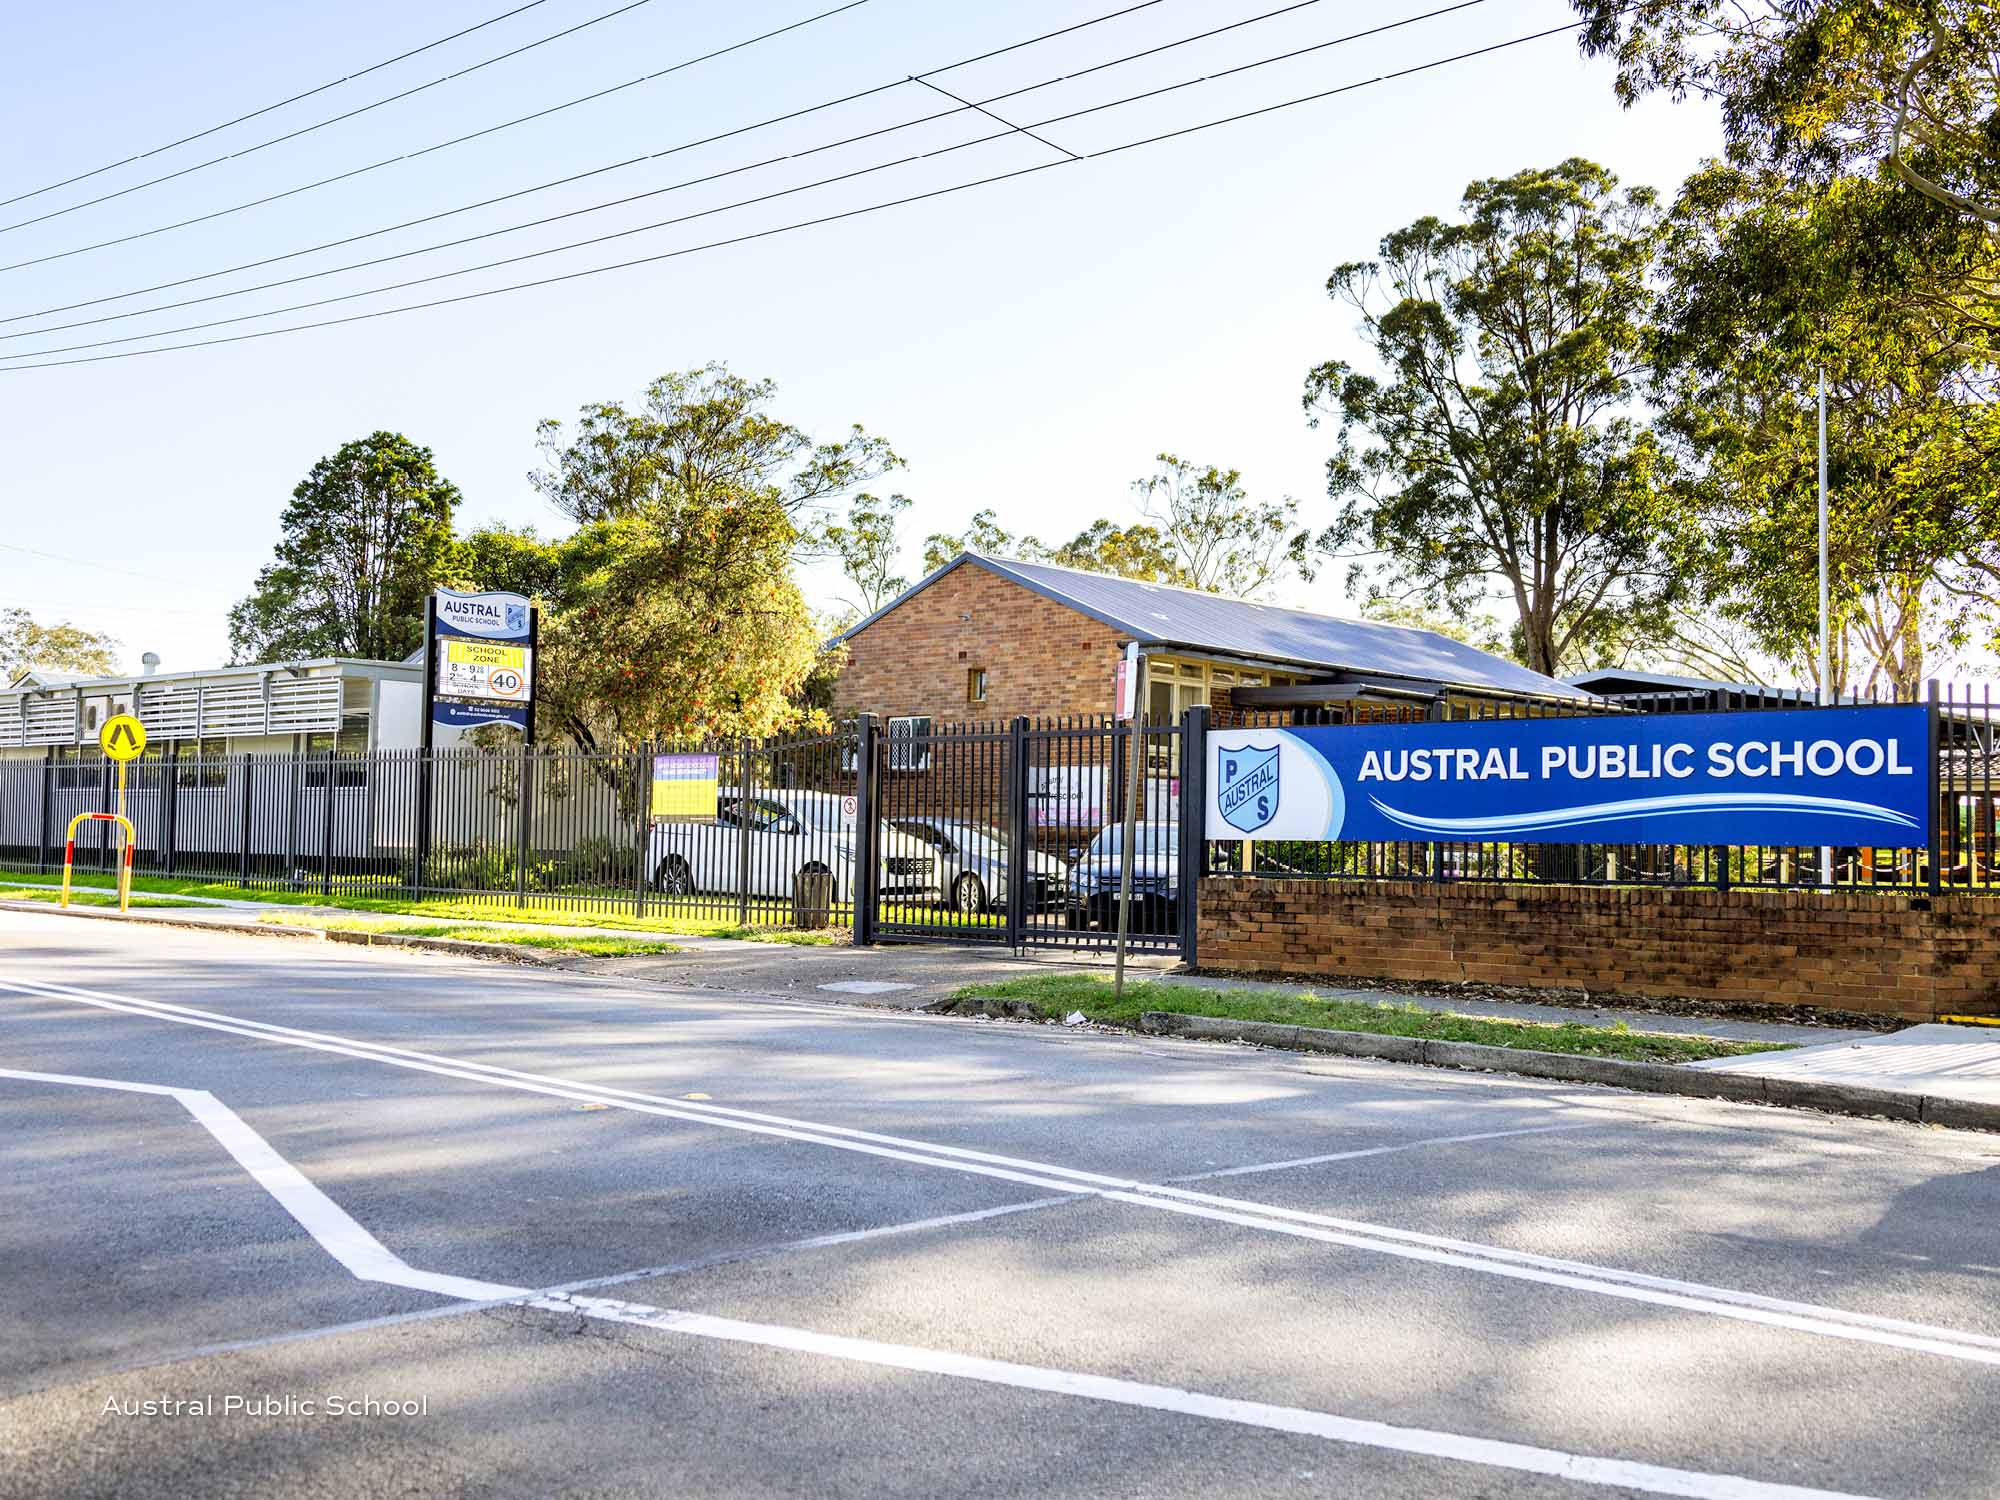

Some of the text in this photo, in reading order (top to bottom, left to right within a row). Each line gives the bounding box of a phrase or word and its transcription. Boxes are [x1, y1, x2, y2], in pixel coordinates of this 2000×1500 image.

[444, 601, 501, 618] AUSTRAL
[452, 615, 474, 623] PUBLIC
[475, 618, 500, 626] SCHOOL
[466, 646, 507, 656] SCHOOL
[473, 655, 500, 664] ZONE
[494, 674, 517, 689] 40
[1357, 738, 1913, 783] AUSTRAL PUBLIC SCHOOL
[1226, 760, 1238, 783] P
[1224, 764, 1274, 812] AUSTRAL
[1257, 795, 1269, 821] S
